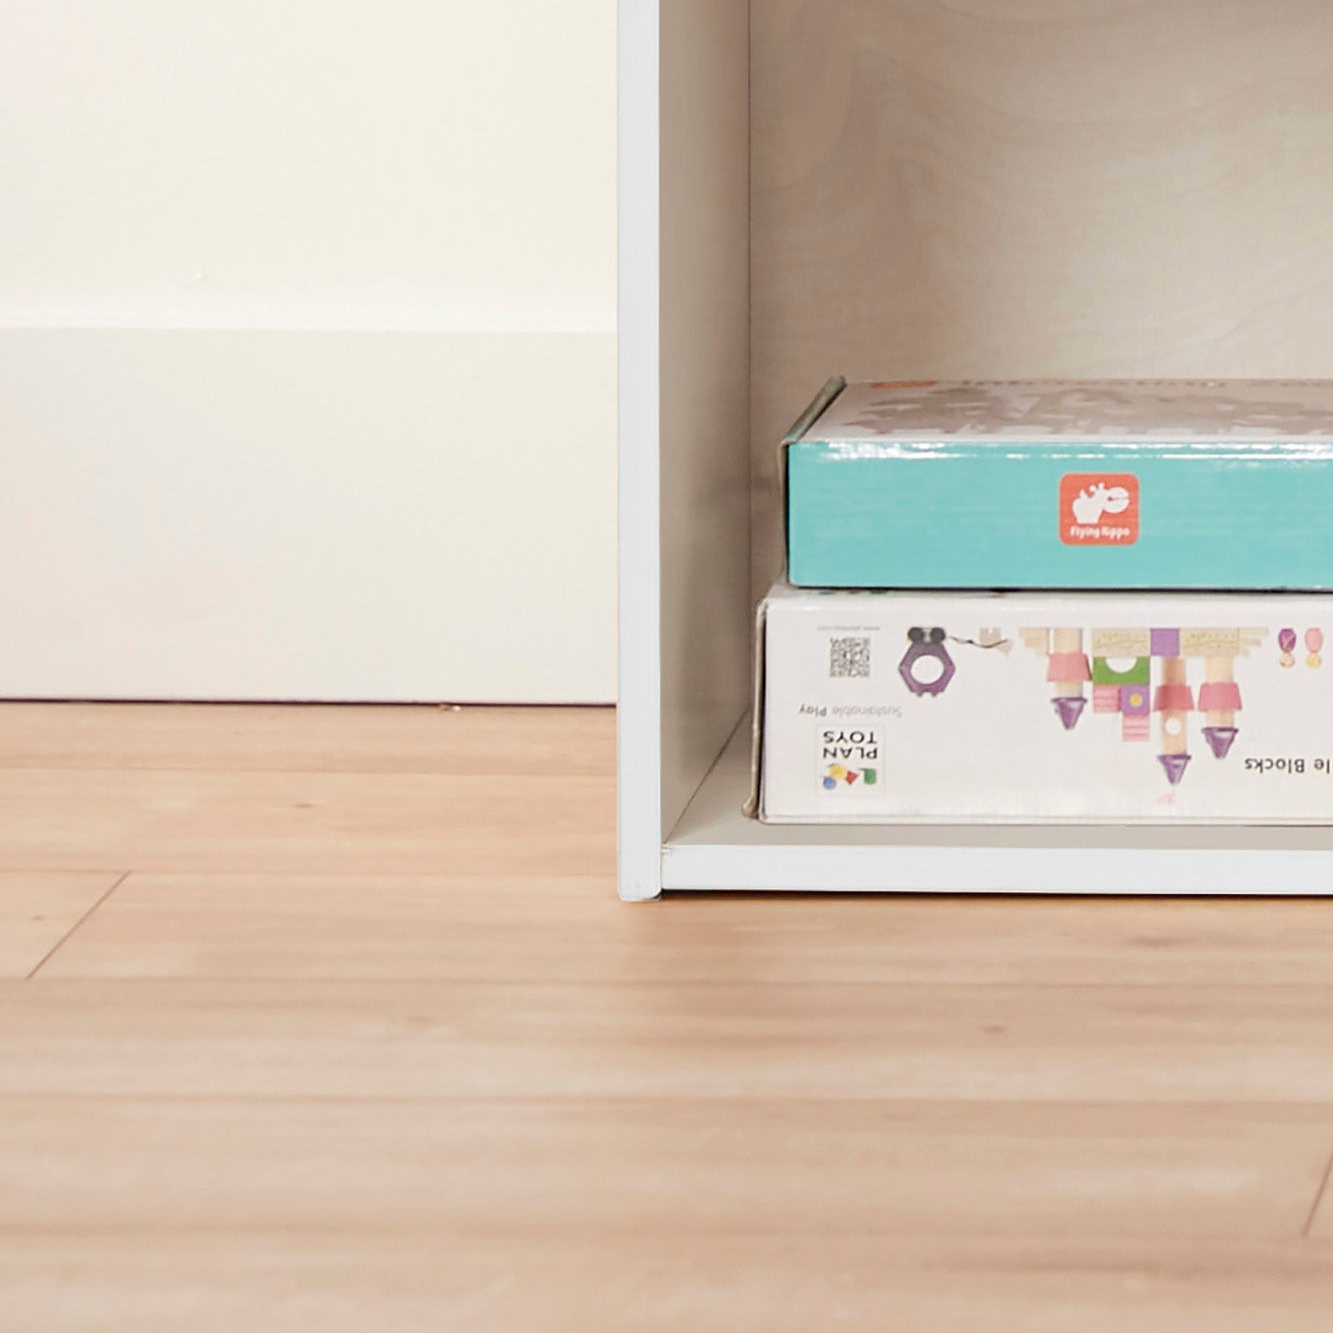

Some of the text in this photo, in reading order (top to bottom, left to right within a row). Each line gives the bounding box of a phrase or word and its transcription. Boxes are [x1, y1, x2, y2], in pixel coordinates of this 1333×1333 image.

[799, 703, 902, 717] Sustainable Play
[823, 731, 877, 744] TOYS
[823, 747, 877, 759] PLAN
[1245, 758, 1304, 773] Blocks
